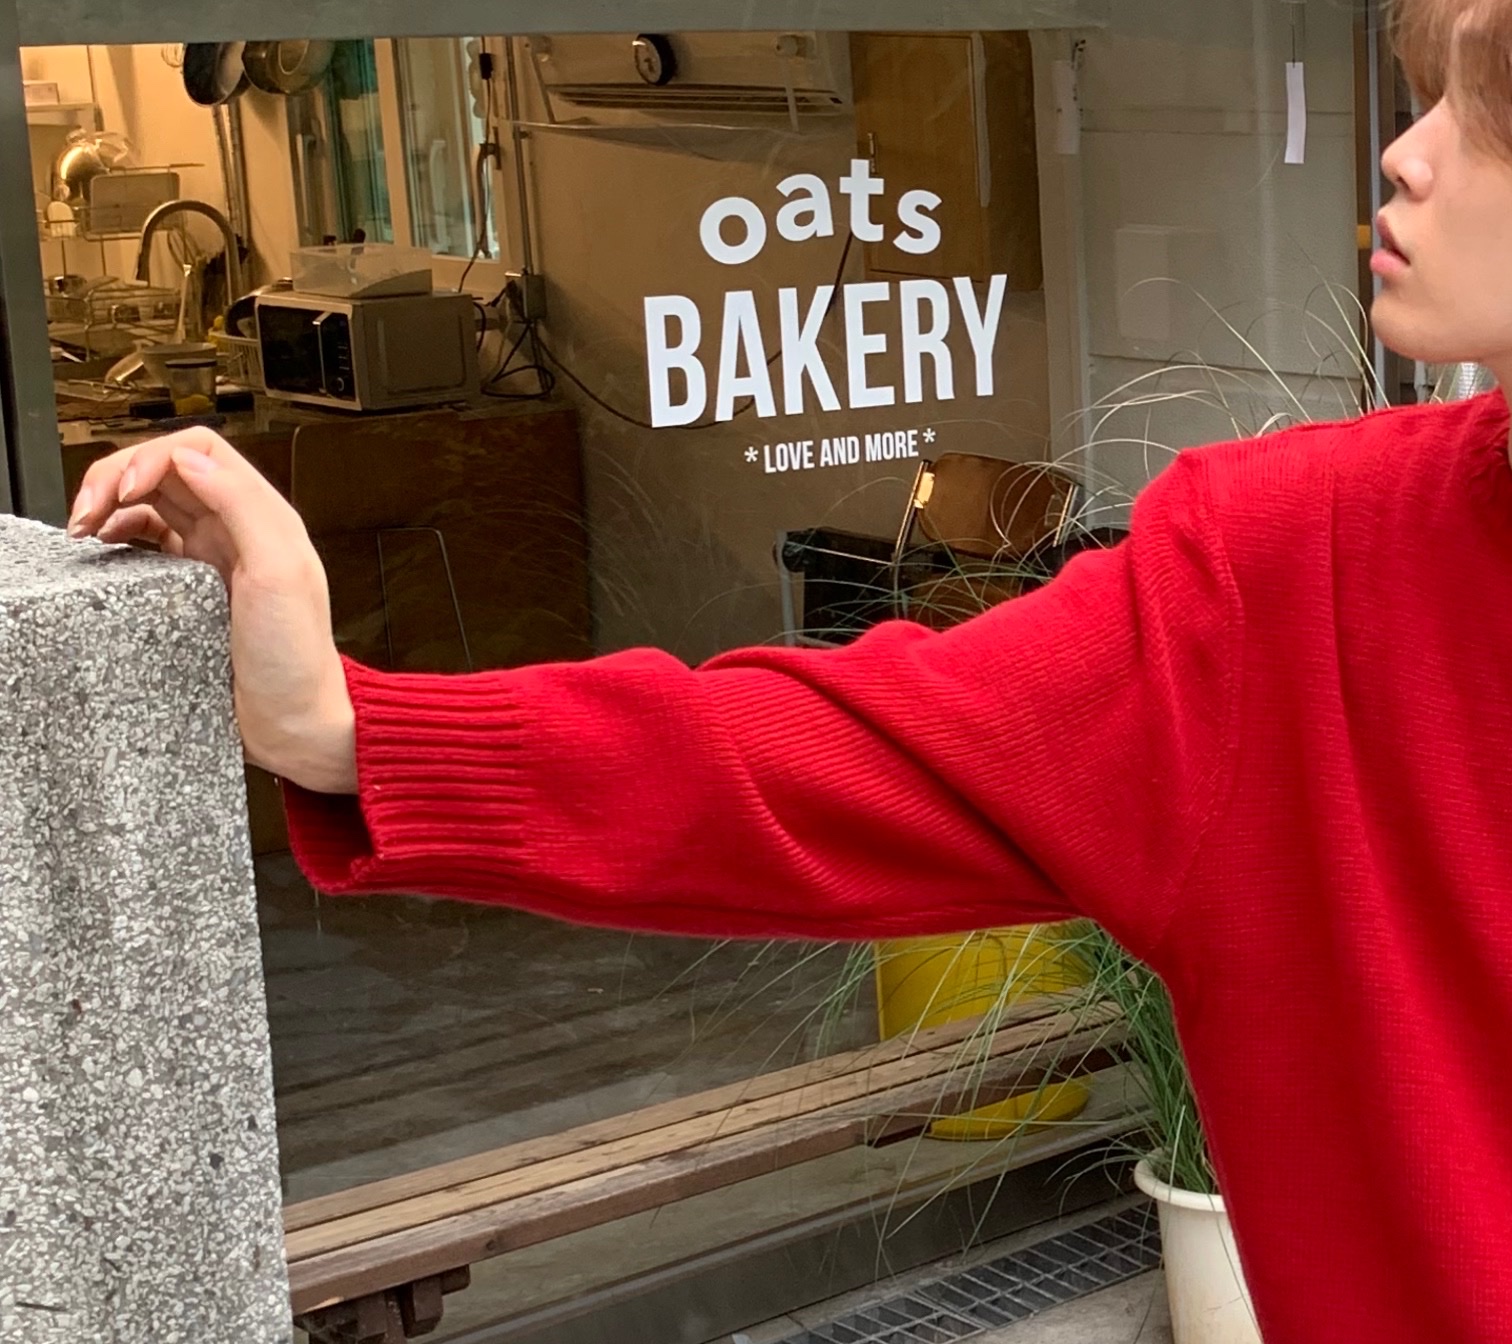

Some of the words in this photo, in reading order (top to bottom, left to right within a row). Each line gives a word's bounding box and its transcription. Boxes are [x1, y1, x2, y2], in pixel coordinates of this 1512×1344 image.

[699, 158, 942, 265] oats
[643, 274, 1007, 428] BAKERY
[763, 441, 815, 474] LOVE
[819, 435, 860, 467] AND
[864, 430, 919, 462] MORE
